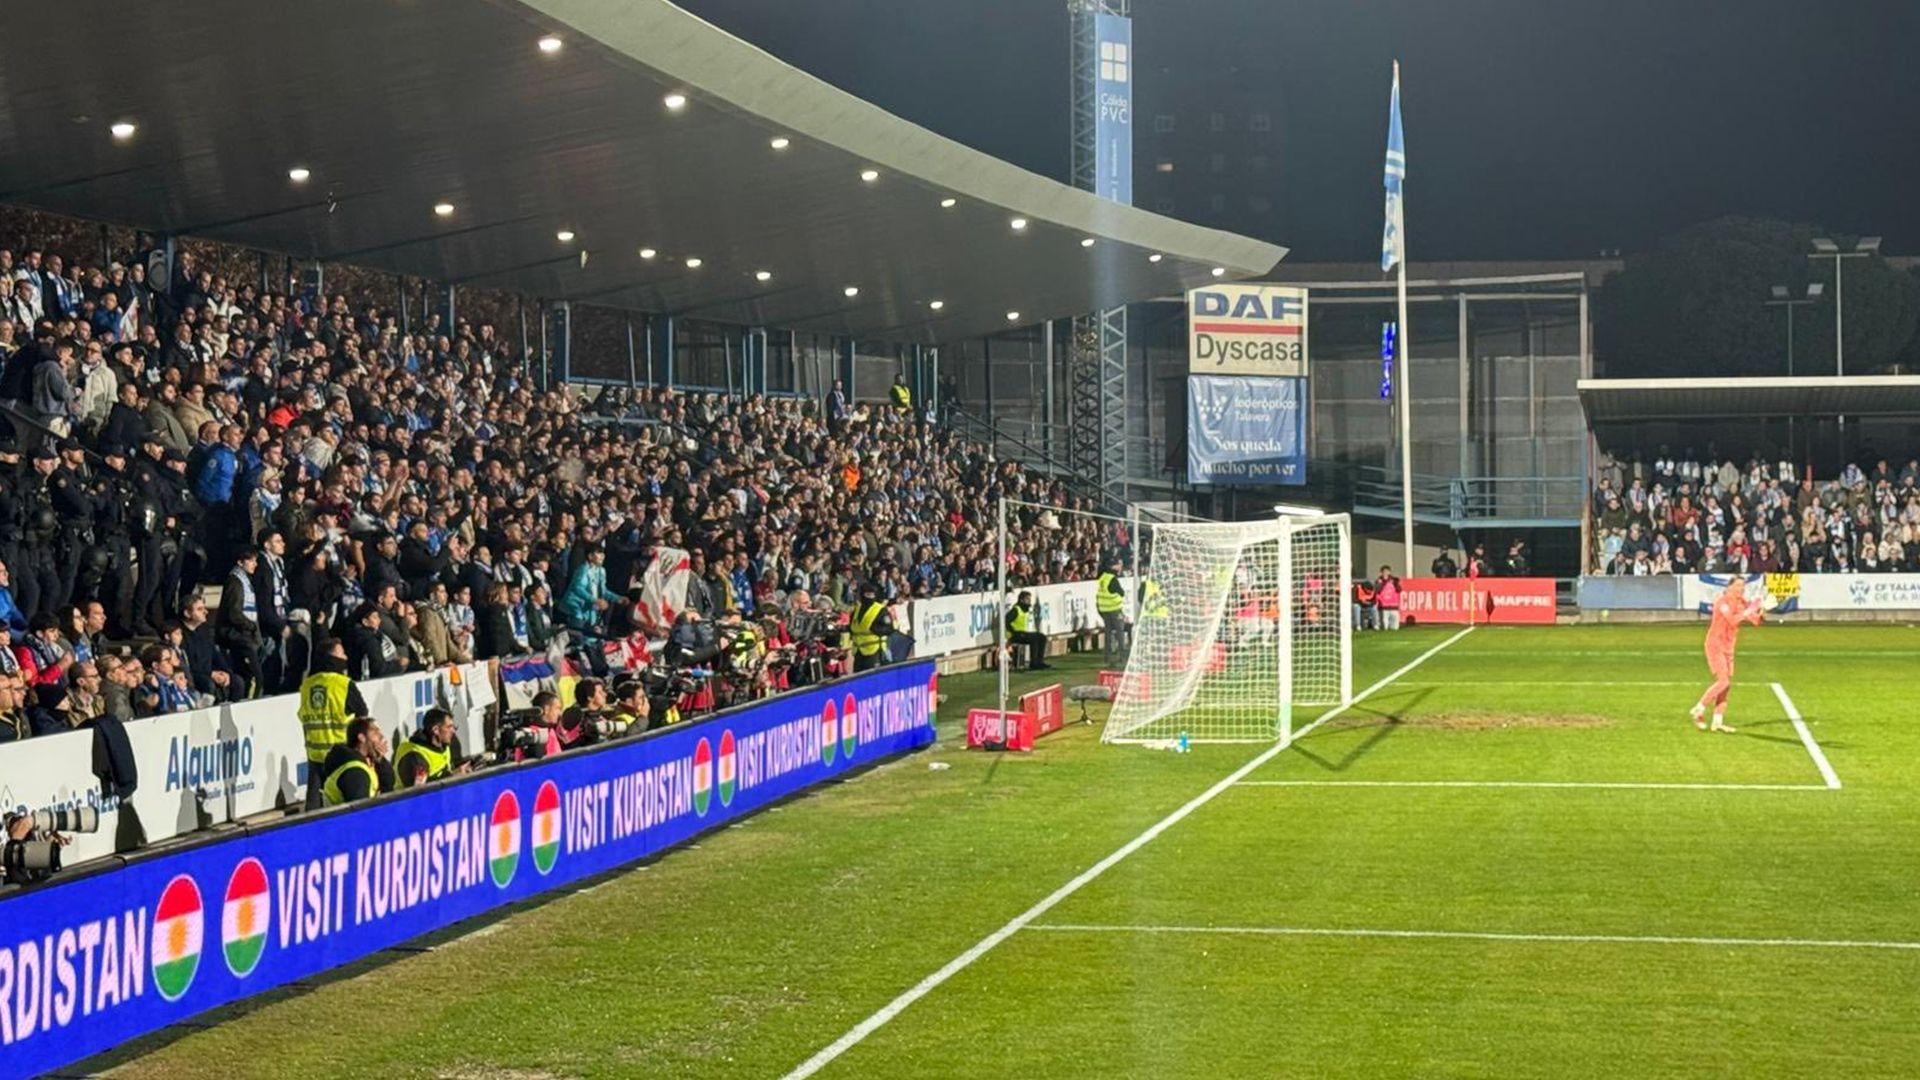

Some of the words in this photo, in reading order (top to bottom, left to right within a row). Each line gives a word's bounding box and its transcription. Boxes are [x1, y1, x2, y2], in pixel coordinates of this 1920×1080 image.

[1101, 107, 1128, 123] PVC
[1195, 291, 1303, 320] DAF
[1196, 333, 1303, 365] Dyscasa
[1241, 437, 1282, 455] queda
[1199, 460, 1246, 475] mucho
[1248, 464, 1274, 478] por
[1400, 591, 1432, 611] COPA
[1437, 590, 1458, 611] DEL
[1493, 596, 1551, 607] MAPFRE
[857, 691, 882, 745] VISIT
[882, 682, 929, 740] KURDISTAN
[165, 730, 252, 794] Alquimo
[737, 730, 765, 791] VISIT
[765, 713, 822, 776] KURDISTAN
[564, 781, 609, 855] VISIT
[611, 756, 692, 840] KURDISTAN
[277, 853, 349, 949] VISIT
[355, 813, 486, 925] KURDISTAN
